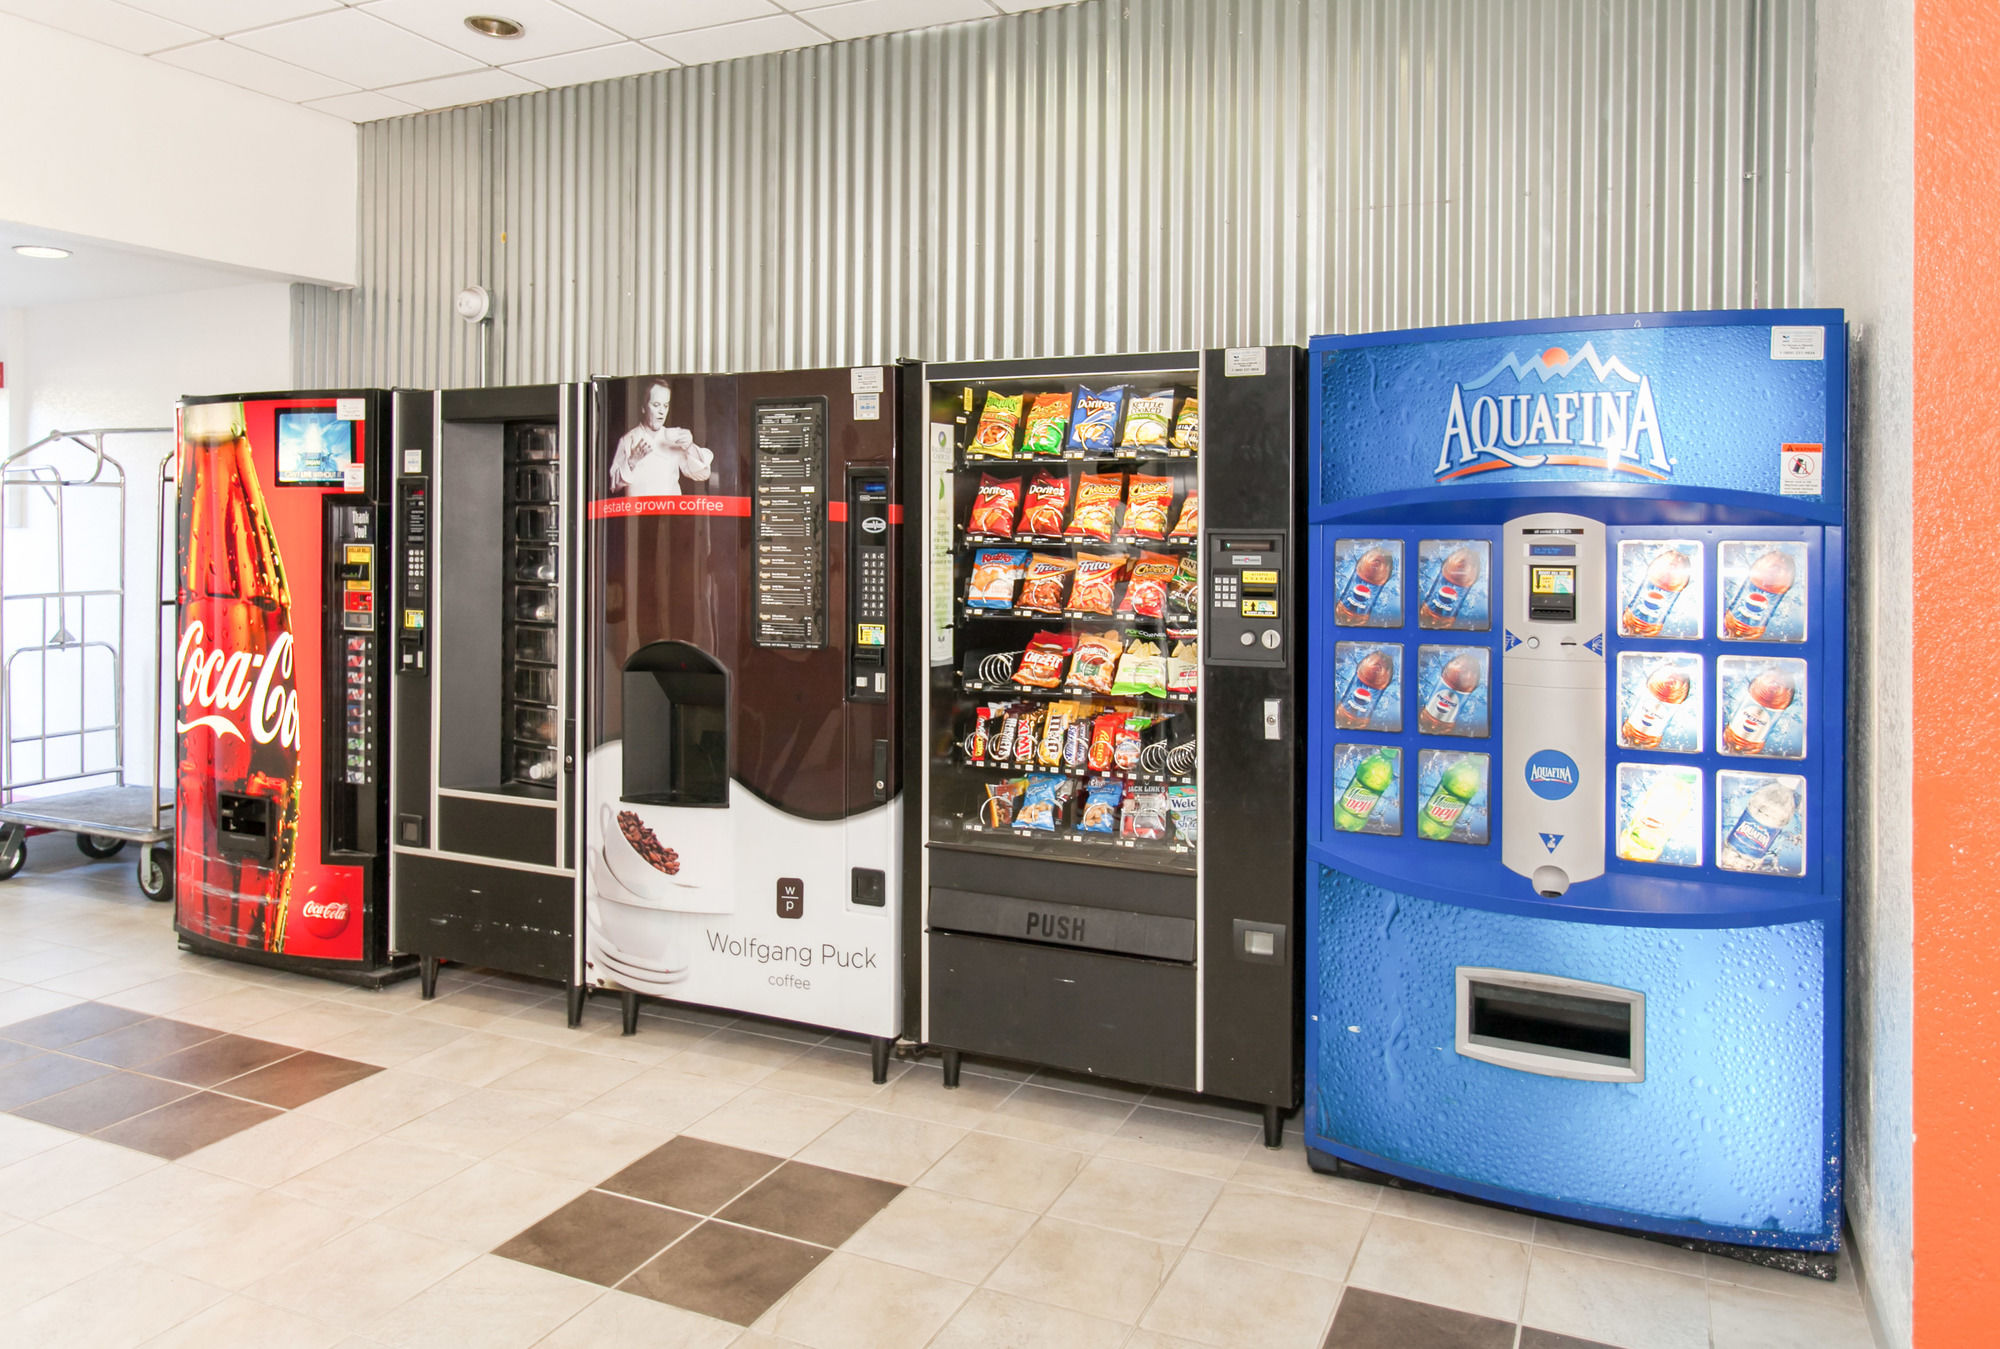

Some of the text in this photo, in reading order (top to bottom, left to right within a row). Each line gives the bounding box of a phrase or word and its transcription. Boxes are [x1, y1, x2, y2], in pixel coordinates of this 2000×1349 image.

[1078, 400, 1117, 412] Doritos
[1434, 375, 1674, 475] AQUAFINA
[1029, 485, 1065, 497] Doritos
[603, 498, 724, 514] estate grown coffee
[1079, 561, 1111, 573] Fritos
[1135, 564, 1174, 576] Cheetos
[1017, 720, 1030, 757] TWIX
[1530, 763, 1573, 784] AQUAFINA
[303, 901, 348, 920] Coca-Cola
[1026, 911, 1086, 942] PUSH
[706, 929, 878, 969] Wolfgang Puck
[768, 974, 811, 990] coffee
